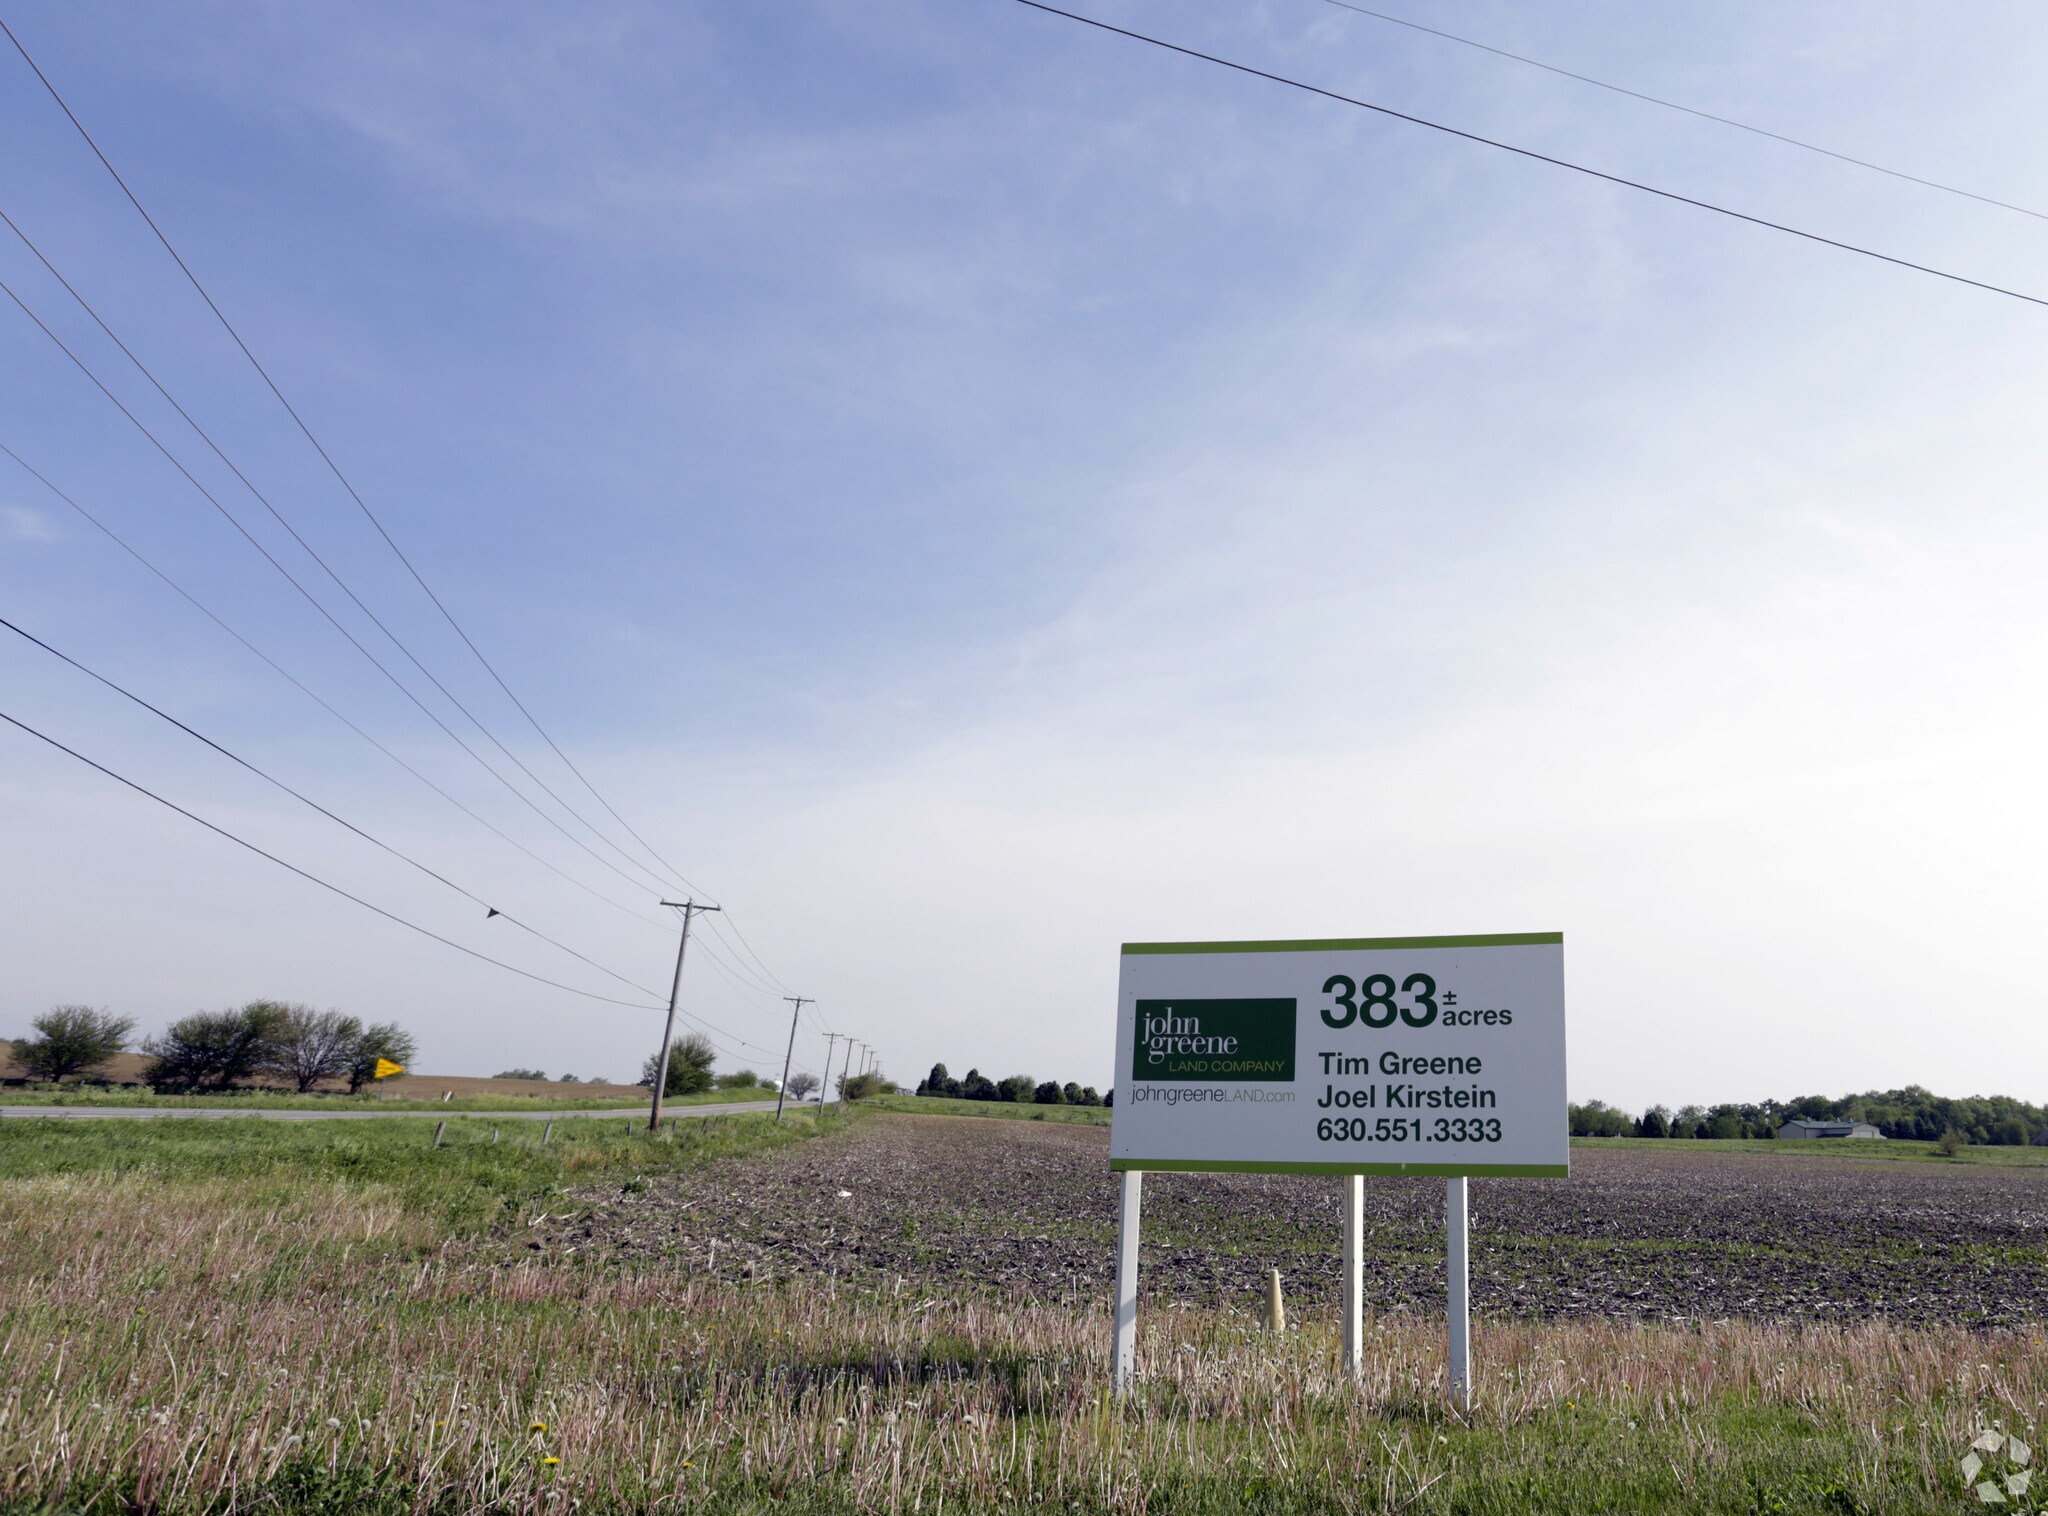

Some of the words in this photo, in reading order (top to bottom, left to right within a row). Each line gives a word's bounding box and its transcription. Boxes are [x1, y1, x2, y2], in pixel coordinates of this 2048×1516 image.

[1320, 973, 1438, 1029] 383
[1141, 1006, 1202, 1045] john
[1442, 1009, 1513, 1026] acres
[1148, 1036, 1238, 1065] greene
[1169, 1061, 1208, 1072] LAND
[1211, 1060, 1286, 1072] COMPANY
[1318, 1052, 1369, 1075] Tim
[1379, 1051, 1482, 1076] Greene
[1131, 1085, 1295, 1106] johngreeneLAND.com
[1317, 1084, 1376, 1108] Joel
[1386, 1084, 1496, 1108] Kirstein
[1317, 1118, 1502, 1142] 630.551.3333
